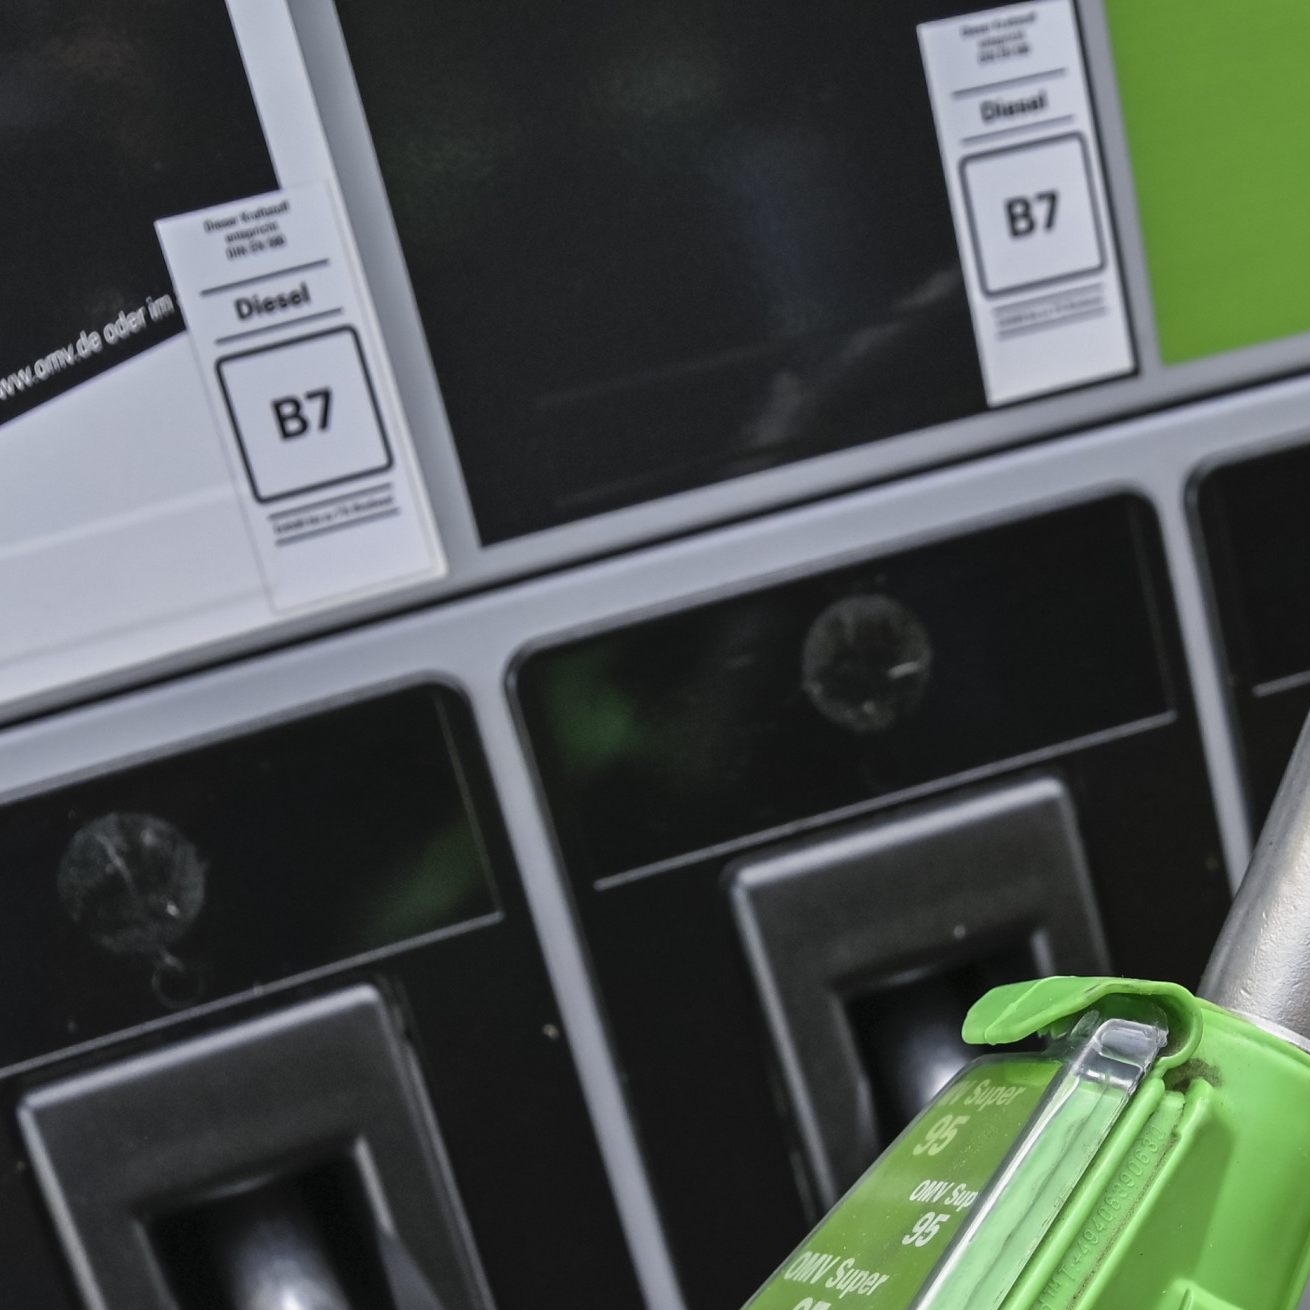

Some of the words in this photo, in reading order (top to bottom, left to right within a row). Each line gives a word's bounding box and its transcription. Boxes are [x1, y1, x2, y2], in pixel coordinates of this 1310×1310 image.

[1005, 190, 1059, 239] B7
[103, 310, 147, 345] oder
[145, 294, 175, 322] im
[235, 282, 311, 320] Diesel
[272, 387, 333, 441] B7
[964, 1078, 1026, 1112] Super
[912, 1114, 971, 1156] 95
[909, 1179, 954, 1203] OMV
[944, 1183, 979, 1212] Sup
[902, 1211, 951, 1247] 95
[784, 1251, 841, 1284] OMV
[825, 1257, 890, 1299] Super
